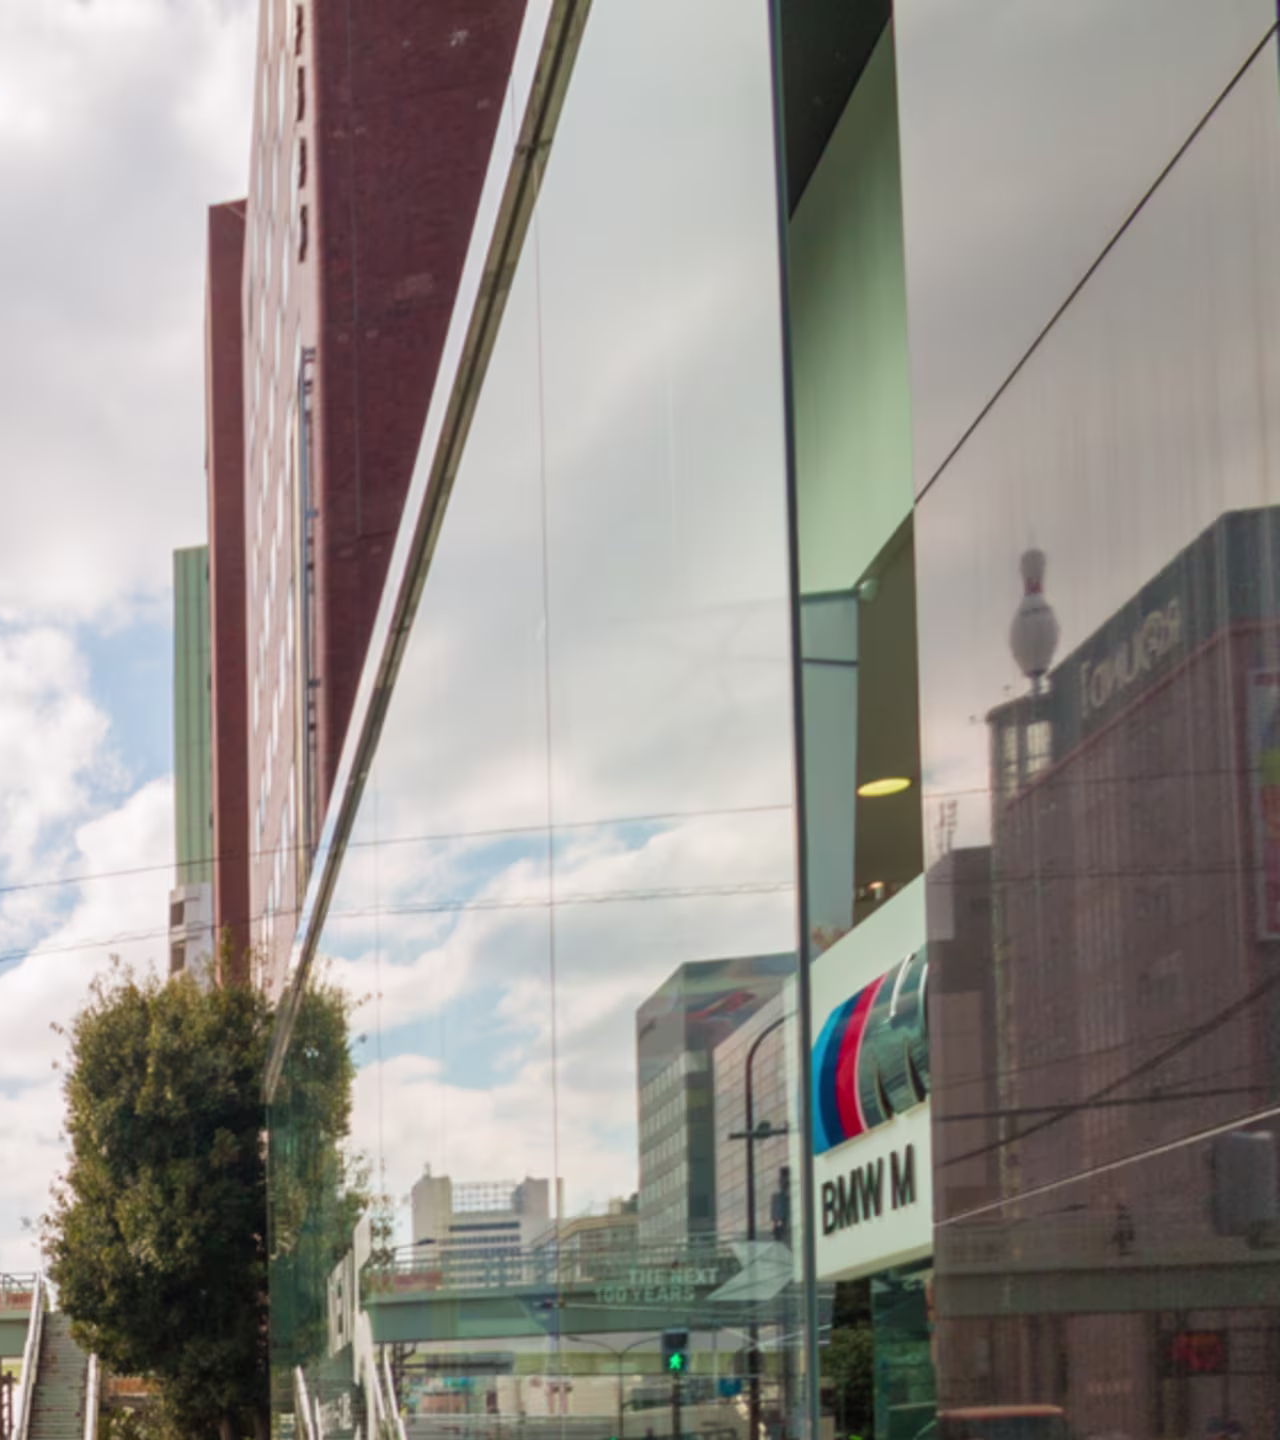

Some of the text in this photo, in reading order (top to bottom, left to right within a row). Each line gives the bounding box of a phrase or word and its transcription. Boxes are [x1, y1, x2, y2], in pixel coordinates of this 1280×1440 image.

[821, 1144, 915, 1236] BMW M
[629, 1267, 720, 1285] THE NEXT
[594, 1285, 696, 1302] 100 YEARS
